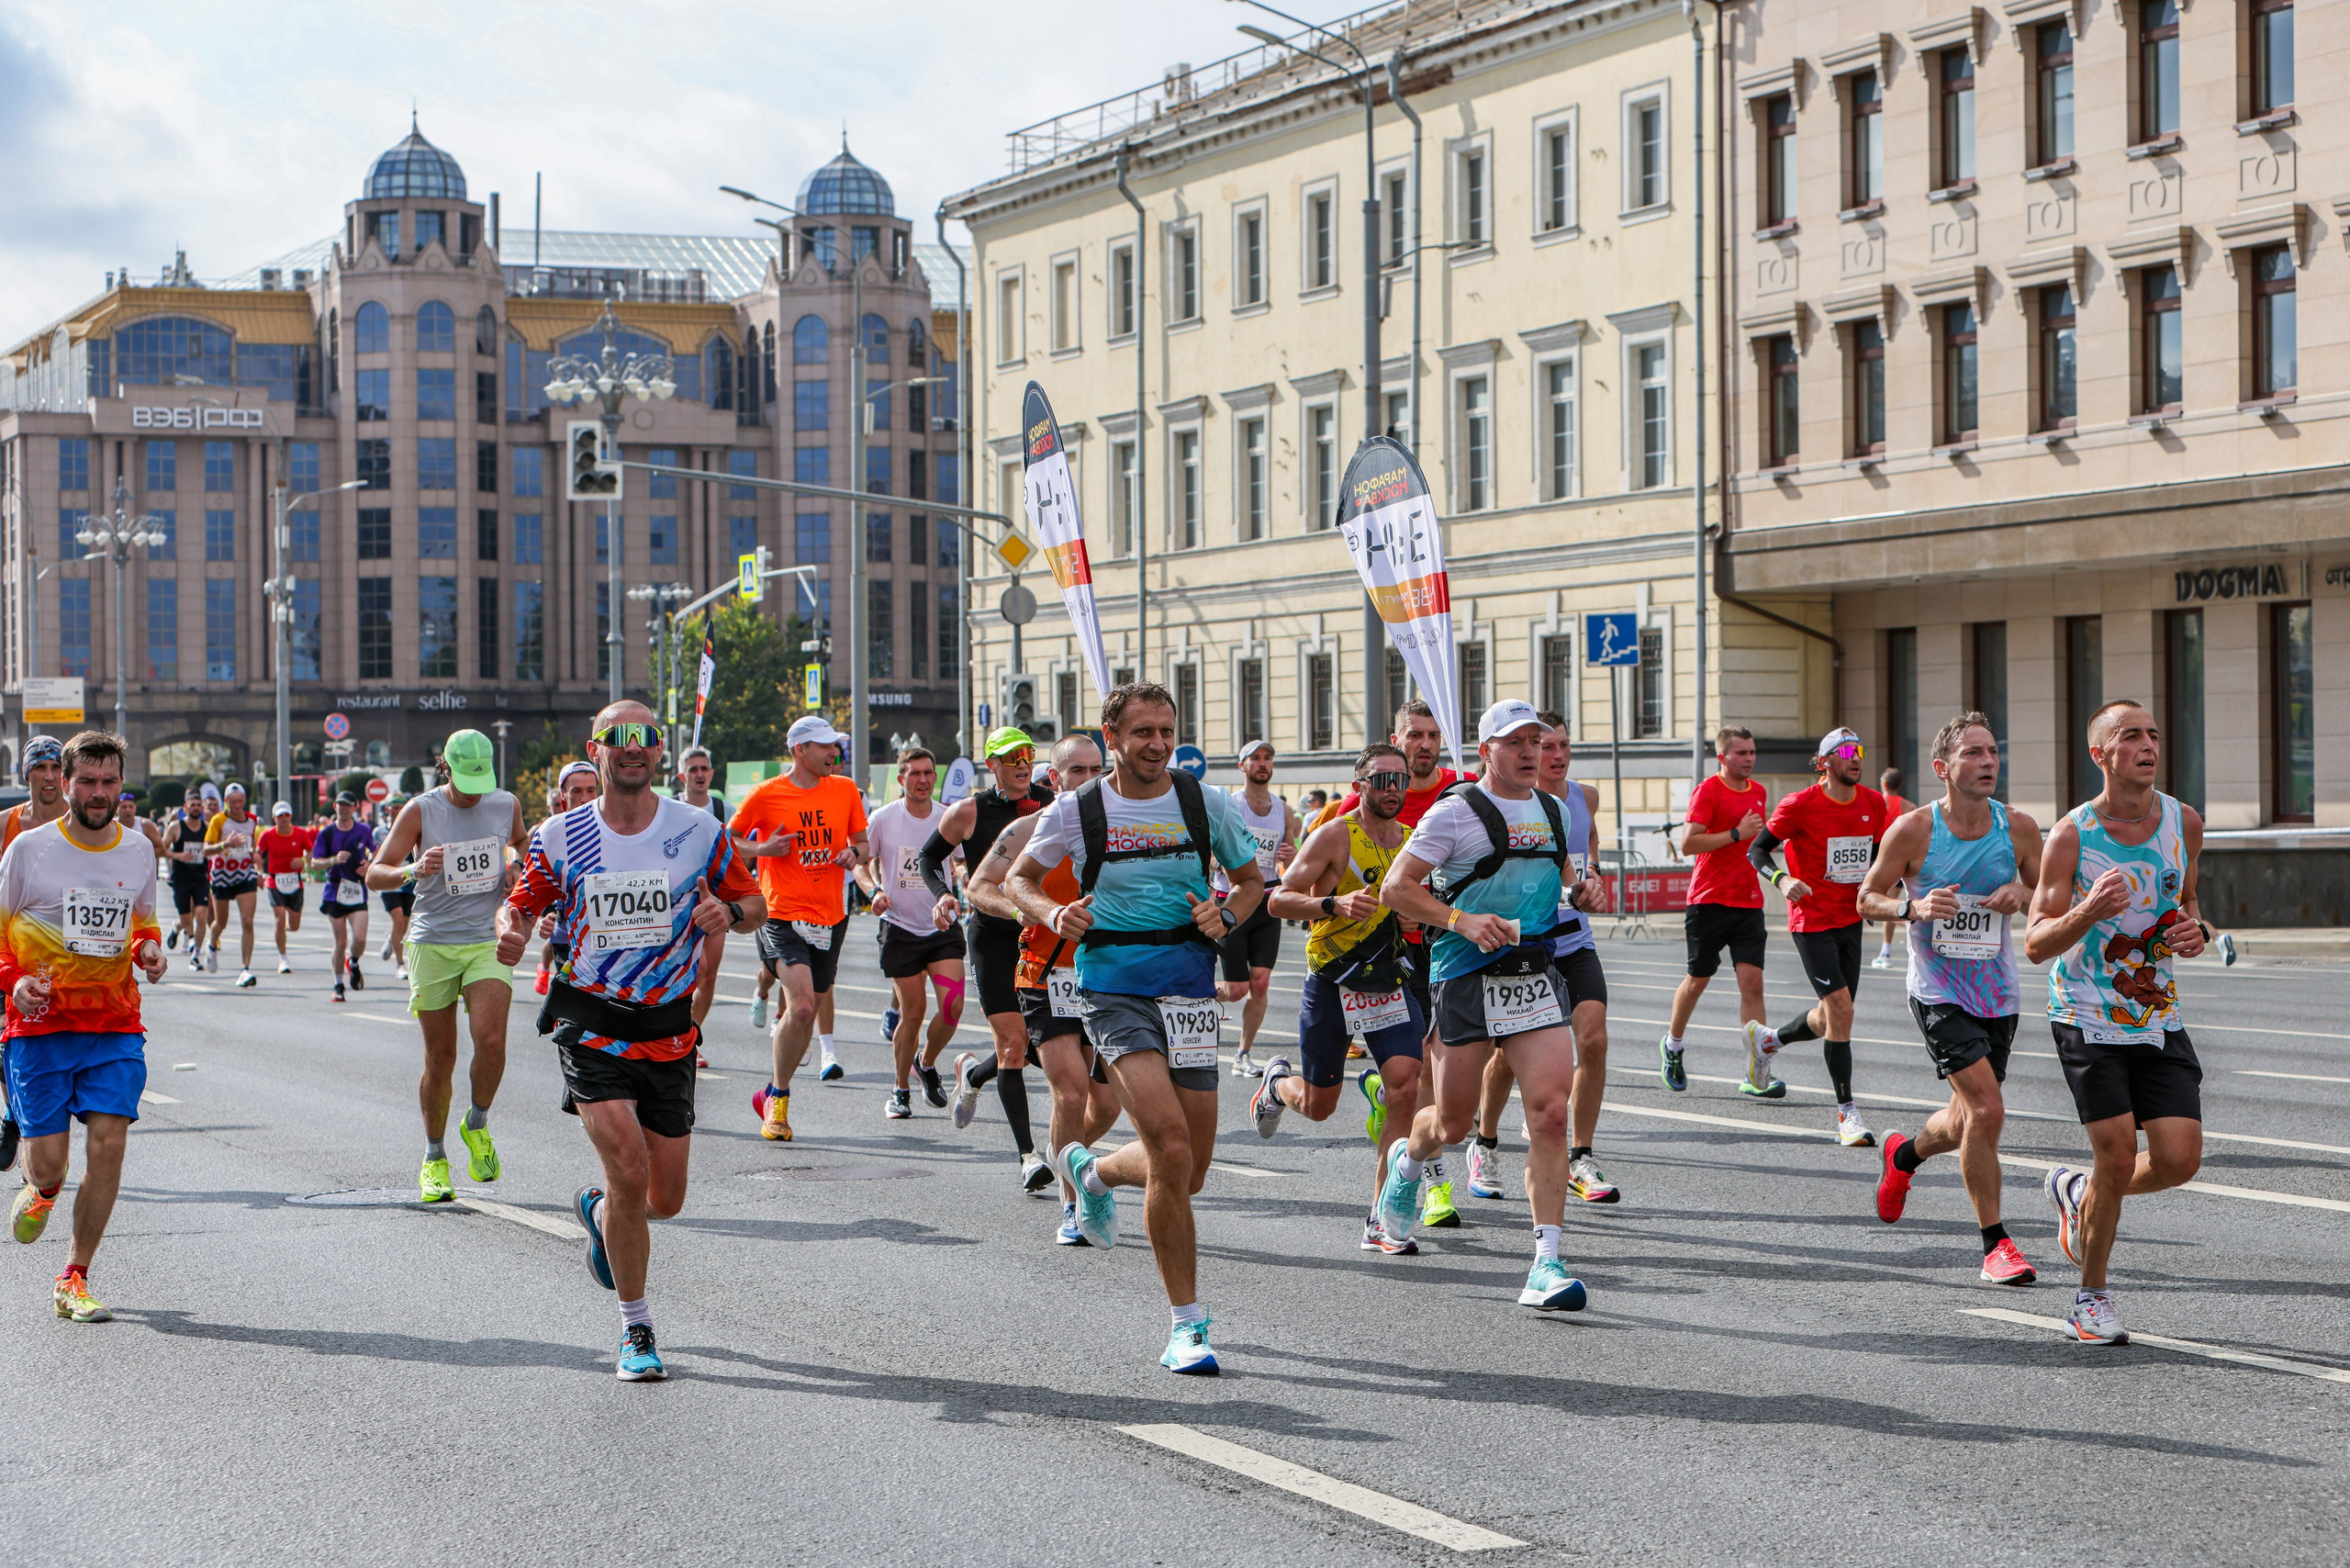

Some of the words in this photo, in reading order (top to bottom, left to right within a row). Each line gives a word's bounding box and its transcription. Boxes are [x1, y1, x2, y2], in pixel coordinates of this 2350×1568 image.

[2175, 564, 2286, 602] DOGMA
[338, 695, 400, 709] restaurant
[419, 690, 468, 710] selfie
[799, 810, 825, 827] WE
[797, 827, 832, 847] RUN
[1107, 823, 1188, 839] МАРАФОН
[1106, 835, 1179, 853] МОСКВА
[456, 853, 490, 872] 818
[802, 850, 829, 865] MSK
[1832, 848, 1867, 865] 8558
[1575, 868, 1583, 881] 7
[451, 885, 459, 895] B
[627, 879, 646, 889] 42,2
[901, 880, 907, 889] B
[589, 890, 667, 918] 17040
[67, 904, 128, 928] 13571
[605, 916, 654, 927] КОНСТАНТИН
[1942, 911, 1991, 933] 5801
[80, 928, 115, 937] ВЛАДИСЛАВ
[1952, 933, 1981, 941] НИКОЛАЙ
[70, 941, 79, 952] C
[598, 935, 607, 948] D
[1938, 945, 1946, 955] C
[33, 974, 52, 1023] МОСВА
[1486, 979, 1551, 1008] 19932
[1058, 1007, 1066, 1015] B
[1506, 1005, 1534, 1016] МИХАИЛ
[1166, 1010, 1216, 1035] 19933
[1353, 1021, 1361, 1031] G
[1493, 1023, 1504, 1035] C
[1182, 1036, 1202, 1047] АЛЕКСЕЙ
[2094, 1033, 2103, 1041] C
[1175, 1052, 1182, 1066] C
